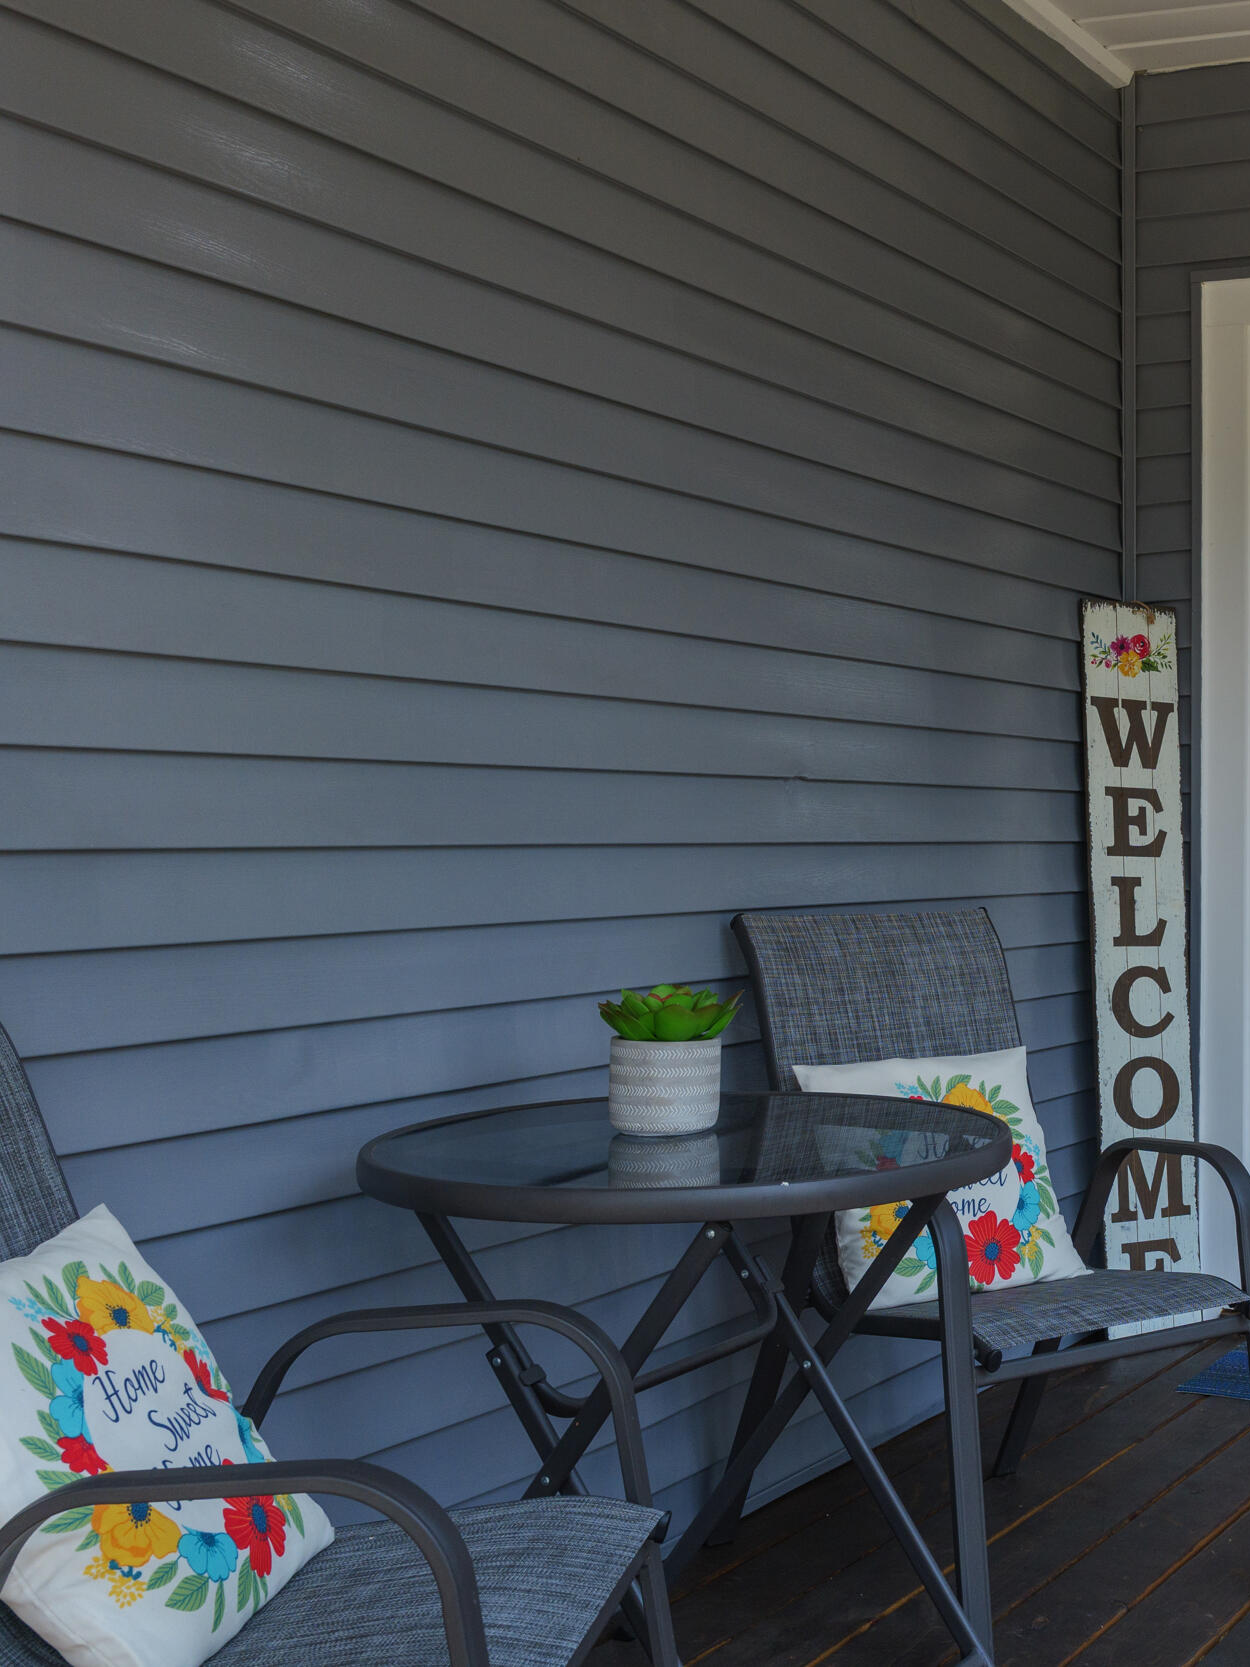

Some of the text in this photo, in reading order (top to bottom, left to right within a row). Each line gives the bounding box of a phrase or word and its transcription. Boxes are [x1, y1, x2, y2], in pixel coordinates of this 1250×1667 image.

[950, 1197, 991, 1218] ome
[92, 1359, 165, 1423] Home
[147, 1382, 217, 1452] Sweet
